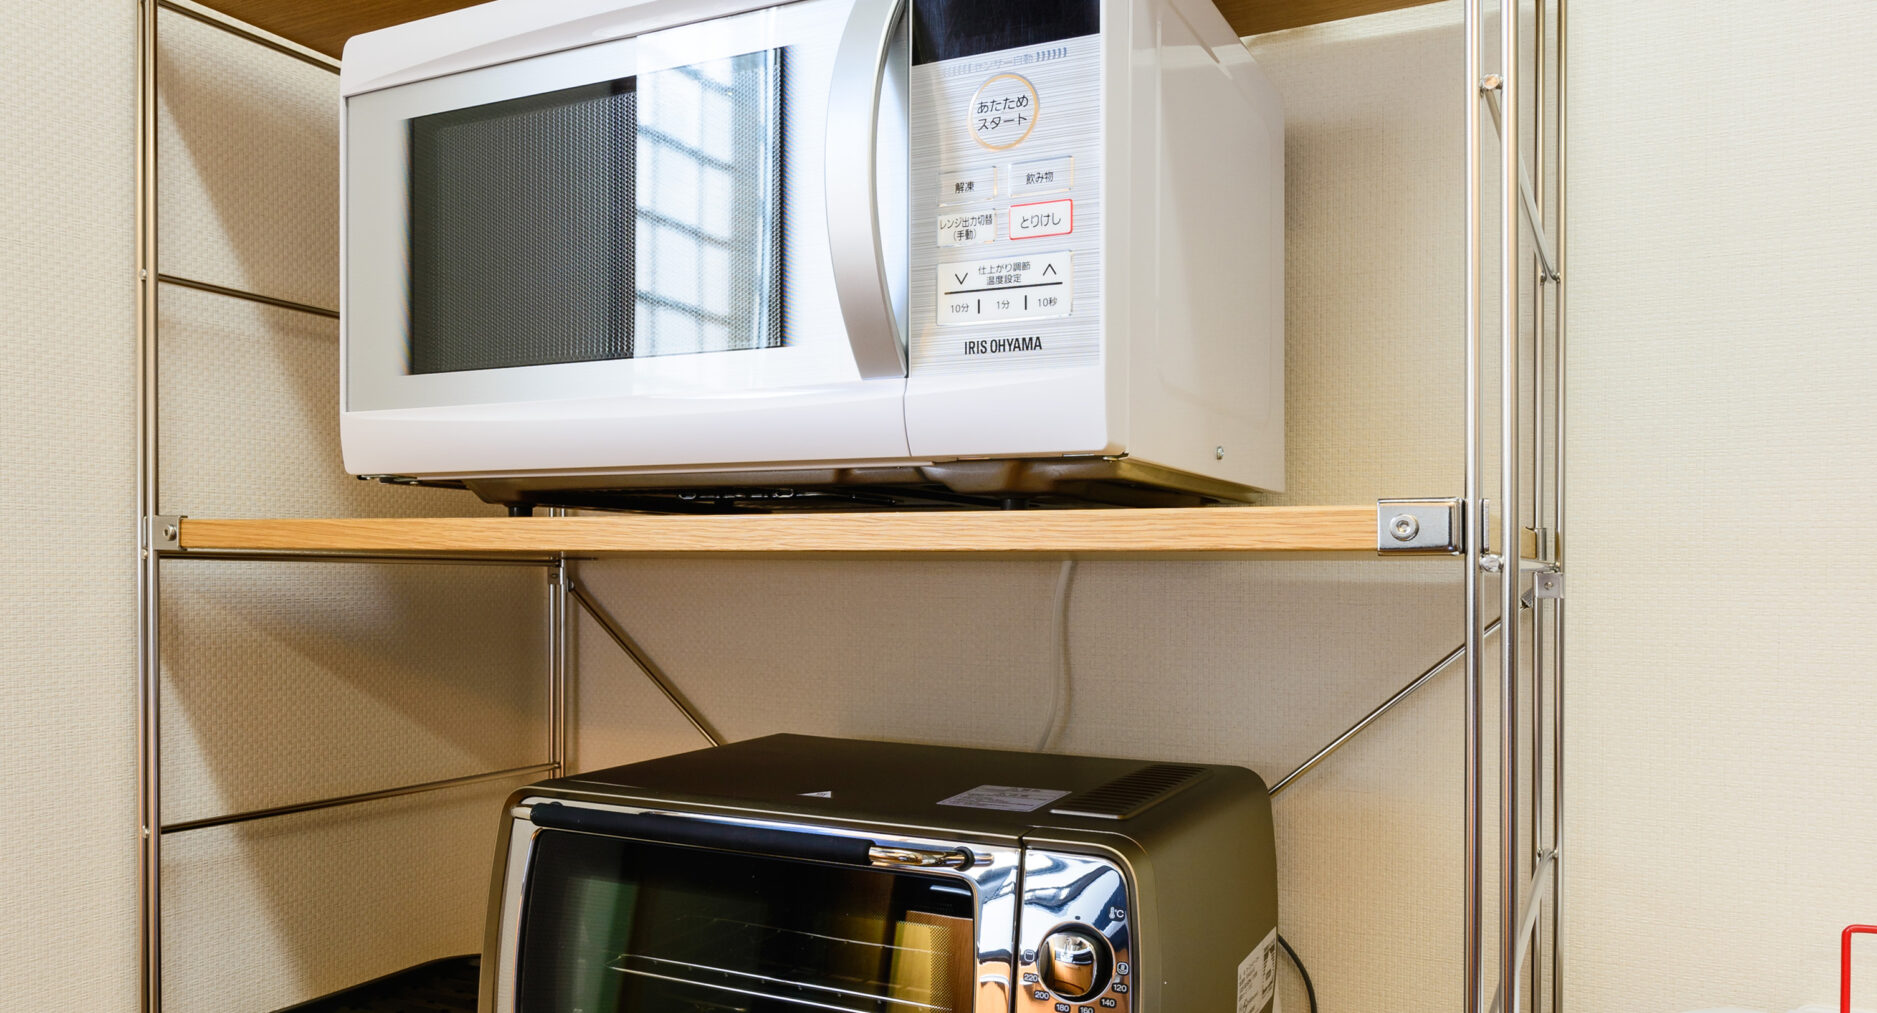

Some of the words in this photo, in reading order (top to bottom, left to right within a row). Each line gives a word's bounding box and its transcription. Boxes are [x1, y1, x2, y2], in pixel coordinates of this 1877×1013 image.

[977, 94, 1029, 114] あたため
[977, 113, 1028, 131] スタート
[1026, 171, 1054, 185] 飲み物
[954, 181, 975, 194] 解凍
[940, 213, 993, 230] レンジ出力切替
[1020, 212, 1061, 229] とりけし
[978, 261, 1031, 275] 仕上がり調節
[986, 274, 1022, 286] 温度設定
[996, 300, 1010, 309] 1分
[1038, 296, 1058, 307] 10秒
[950, 303, 969, 313] 10分
[964, 339, 987, 355] IRIS
[990, 336, 1042, 353] OHYAMA
[1023, 974, 1038, 982] 220
[1113, 984, 1127, 992] 120
[1034, 991, 1049, 1000] 200
[1056, 1003, 1069, 1012] 180
[1101, 999, 1115, 1007] 140
